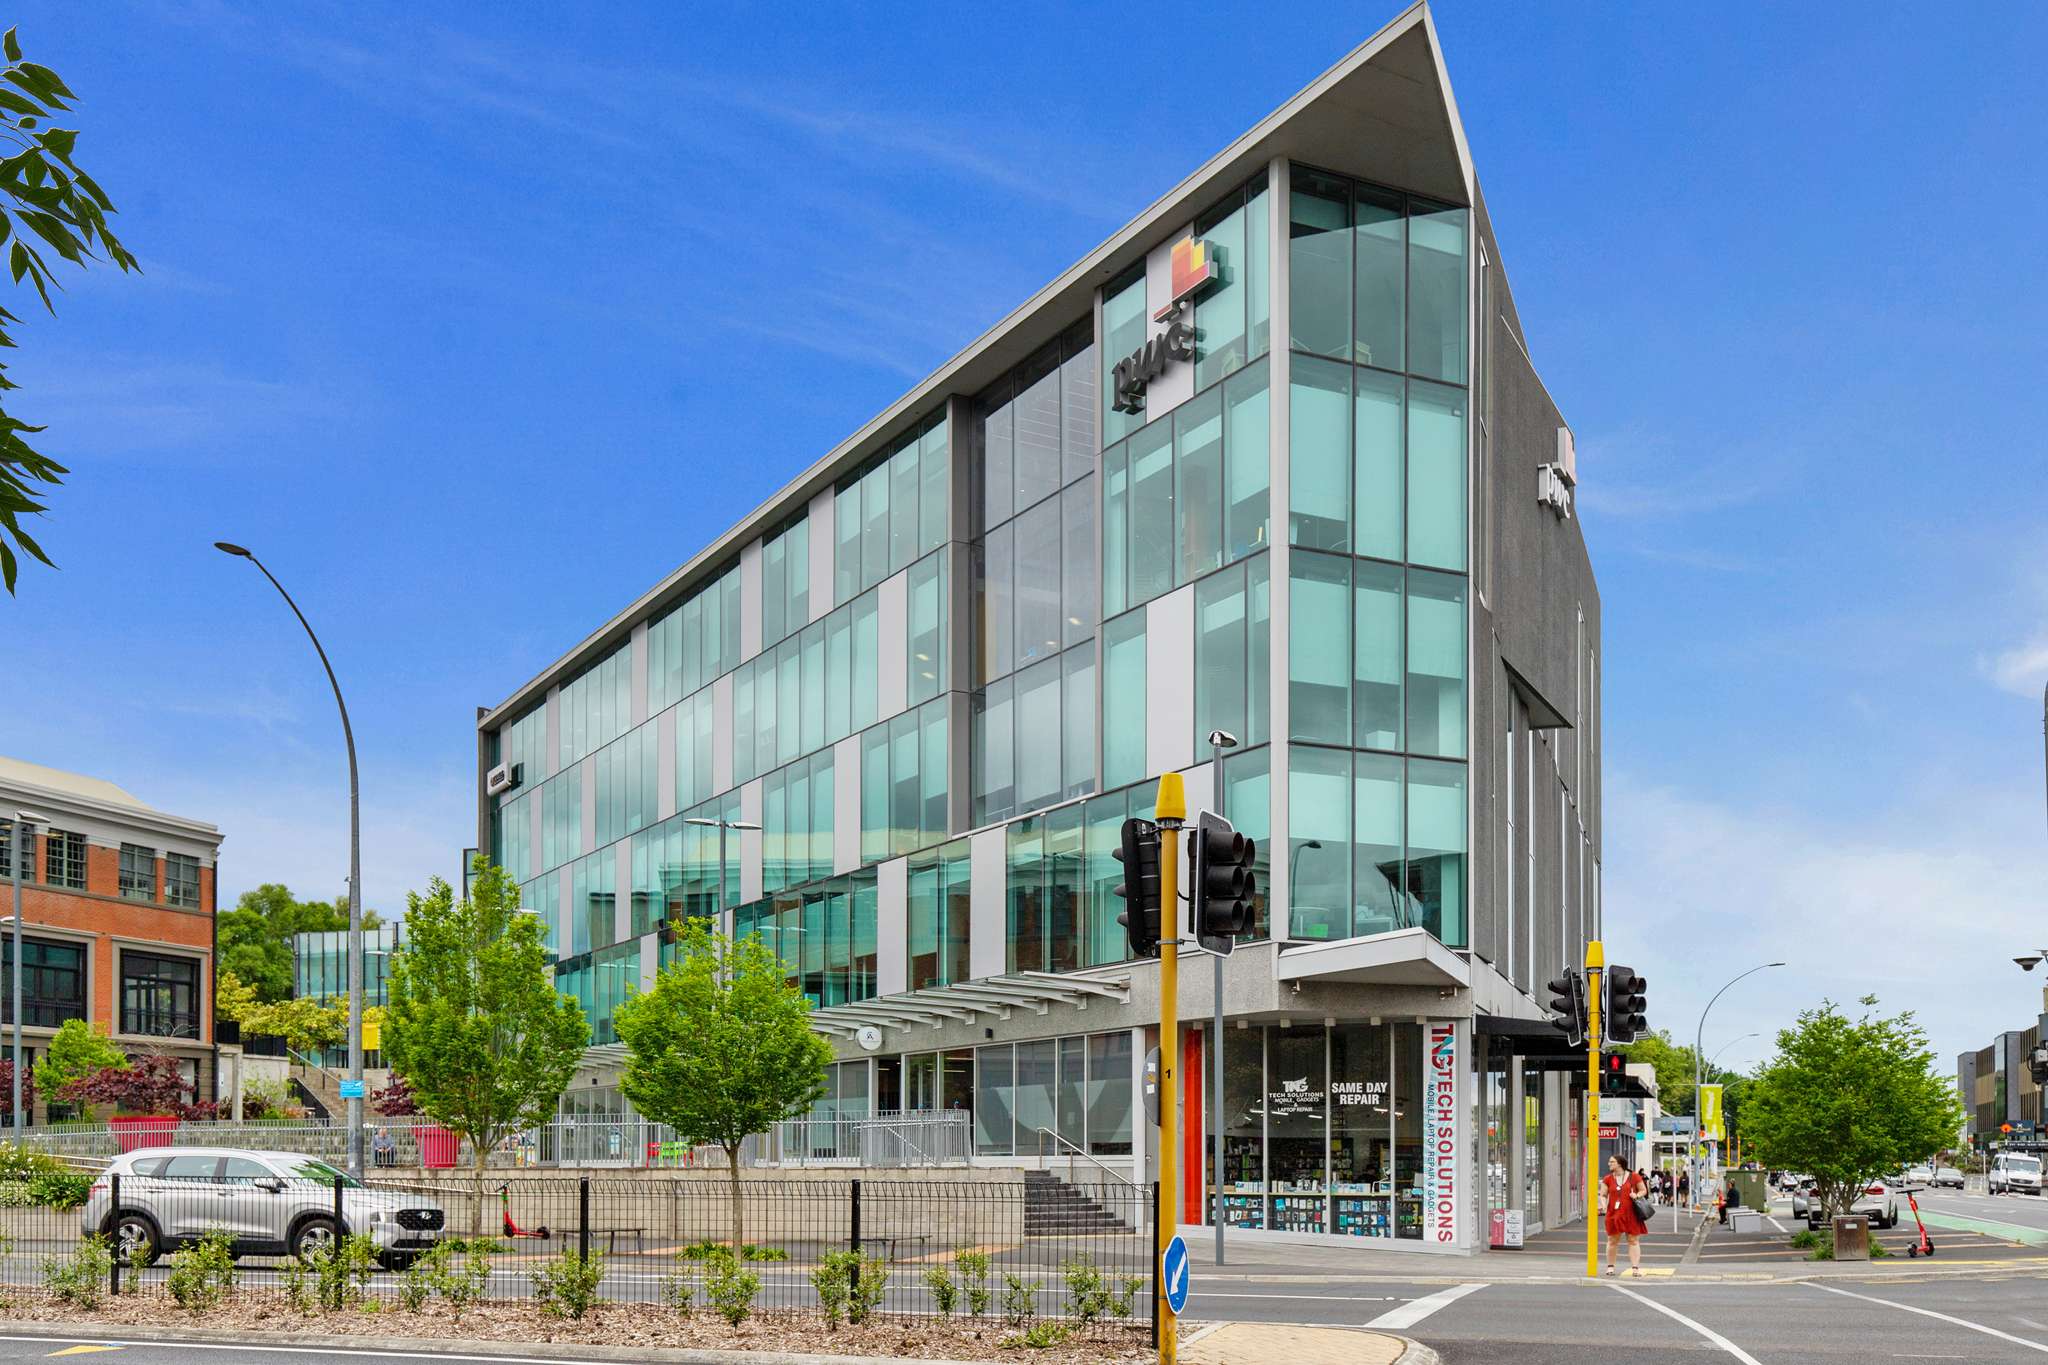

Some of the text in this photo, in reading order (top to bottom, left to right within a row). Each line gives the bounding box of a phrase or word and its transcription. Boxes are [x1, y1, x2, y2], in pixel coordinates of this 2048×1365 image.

[1165, 1068, 1171, 1079] 1
[1331, 1082, 1388, 1094] SAME DAY
[1339, 1094, 1380, 1105] REPAIR
[1437, 1069, 1453, 1121] TECH
[1427, 1119, 1435, 1149] LAPTOP
[1427, 1151, 1435, 1180] REPAIR
[1437, 1127, 1453, 1242] SOLUTIONS
[1427, 1190, 1435, 1228] GADGETS
